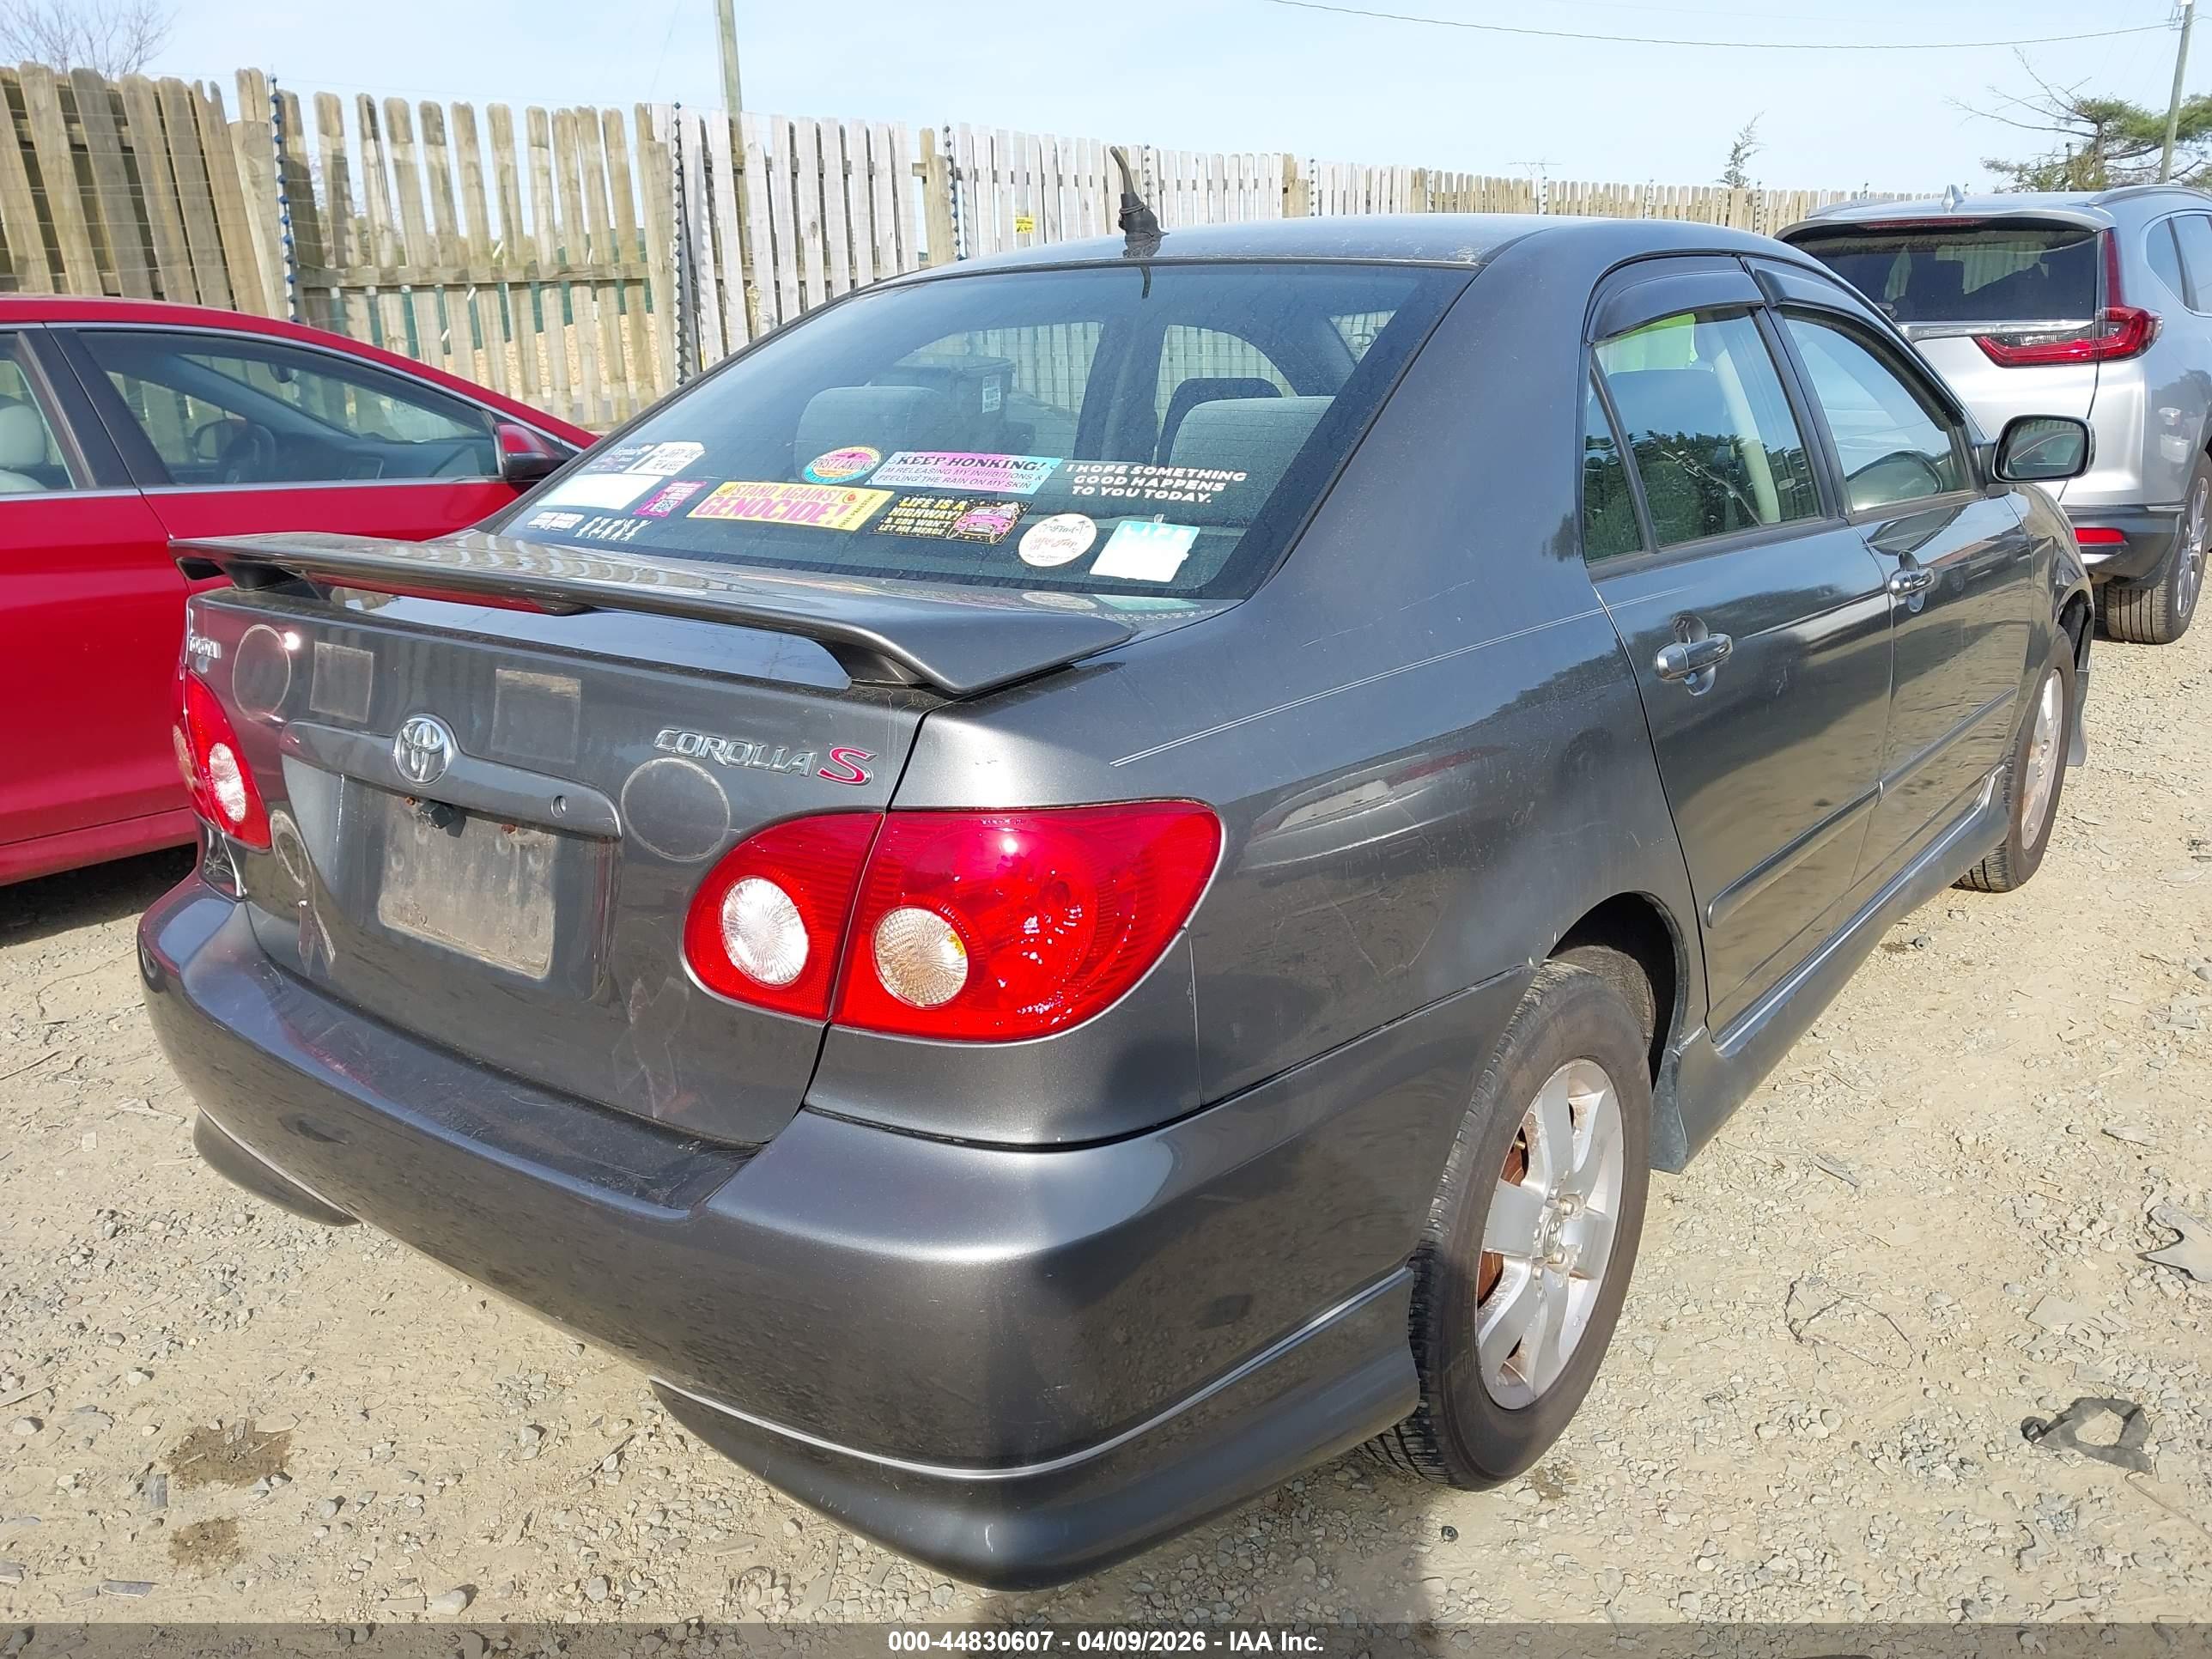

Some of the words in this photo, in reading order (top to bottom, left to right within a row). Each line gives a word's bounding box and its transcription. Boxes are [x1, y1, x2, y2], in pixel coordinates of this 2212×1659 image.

[895, 456, 944, 465] KEEP
[947, 458, 1046, 471] HONKING!
[892, 467, 951, 476] RELEASING
[968, 469, 1034, 479] INHIBITIONS
[1066, 464, 1074, 472] I
[1075, 465, 1127, 474] HOPE
[1130, 465, 1248, 482] SOMETHING
[944, 477, 968, 485] RAIN
[1073, 475, 1128, 485] GOOD
[1130, 477, 1227, 492] HAPPENS
[731, 484, 779, 497] STAND
[779, 486, 847, 502] AGAINST
[1072, 485, 1095, 495] TO
[1099, 487, 1140, 497] YOU
[1143, 489, 1212, 503] TODAY.
[694, 496, 851, 526] GENOCIDE!
[899, 496, 935, 508] LIFE
[933, 499, 950, 510] IS
[952, 500, 968, 511] A
[888, 507, 963, 520] HIGHWAY!
[911, 526, 945, 535] MERGE
[915, 519, 951, 527] WON'T
[653, 729, 817, 777] COROLLA
[817, 746, 878, 786] S
